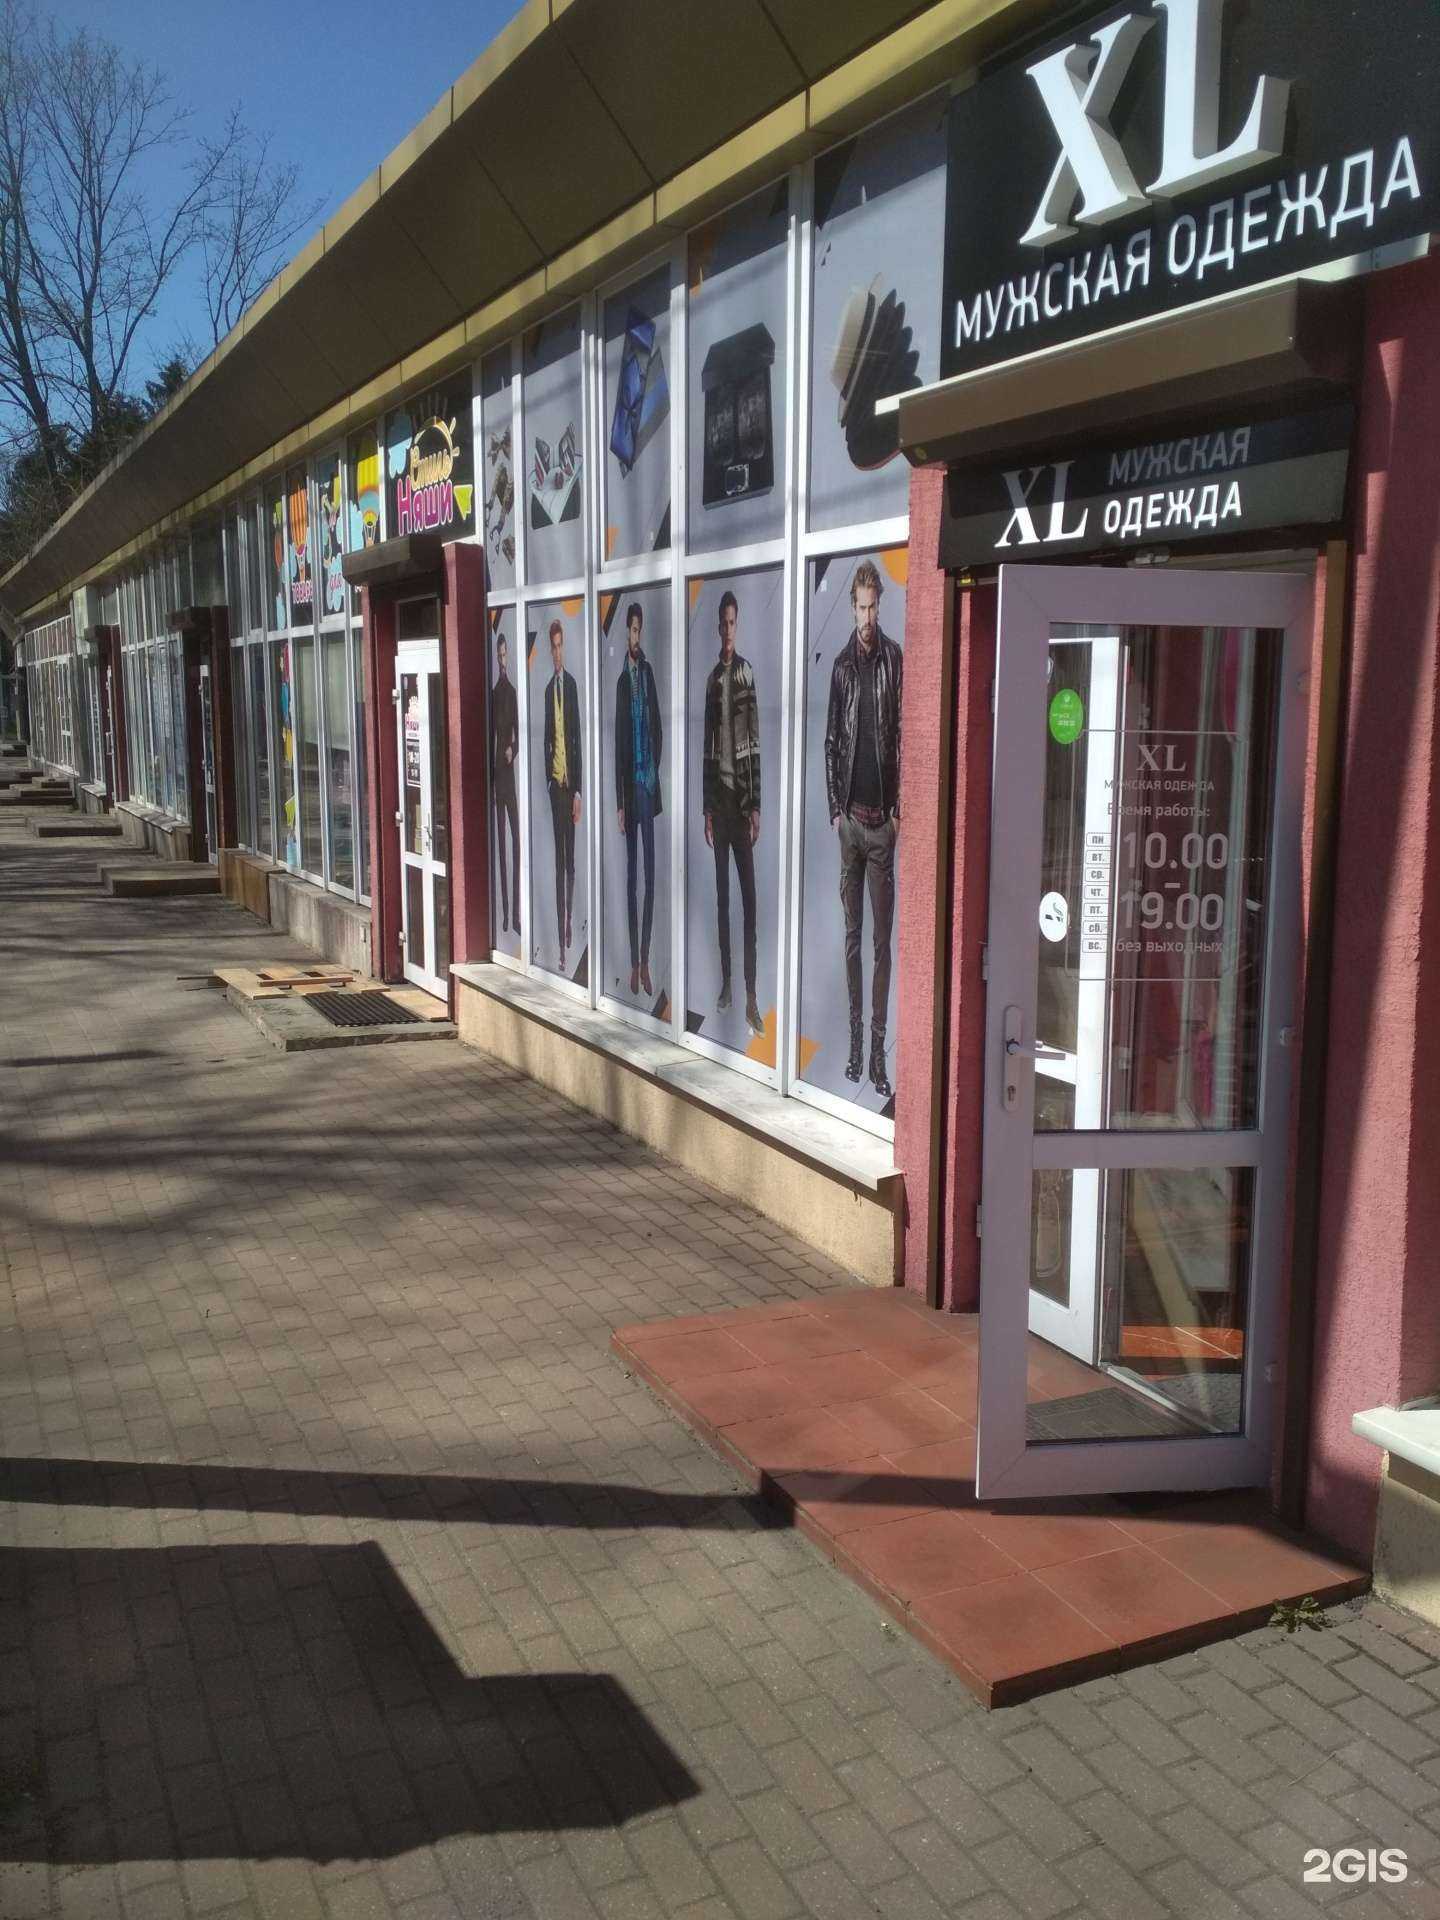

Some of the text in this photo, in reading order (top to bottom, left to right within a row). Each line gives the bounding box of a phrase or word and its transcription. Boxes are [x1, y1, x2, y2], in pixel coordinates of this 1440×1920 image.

[1019, 0, 1288, 247] XL
[953, 134, 1423, 349] МУЖСКАЯ ОДЕЖДА
[1107, 425, 1252, 487] МУЖСКАЯ
[994, 459, 1090, 549] XL
[1102, 479, 1243, 540] ОДЕЖДА
[1136, 743, 1187, 772] XL
[1123, 832, 1229, 870] 10.00
[1119, 890, 1225, 931] 19.00
